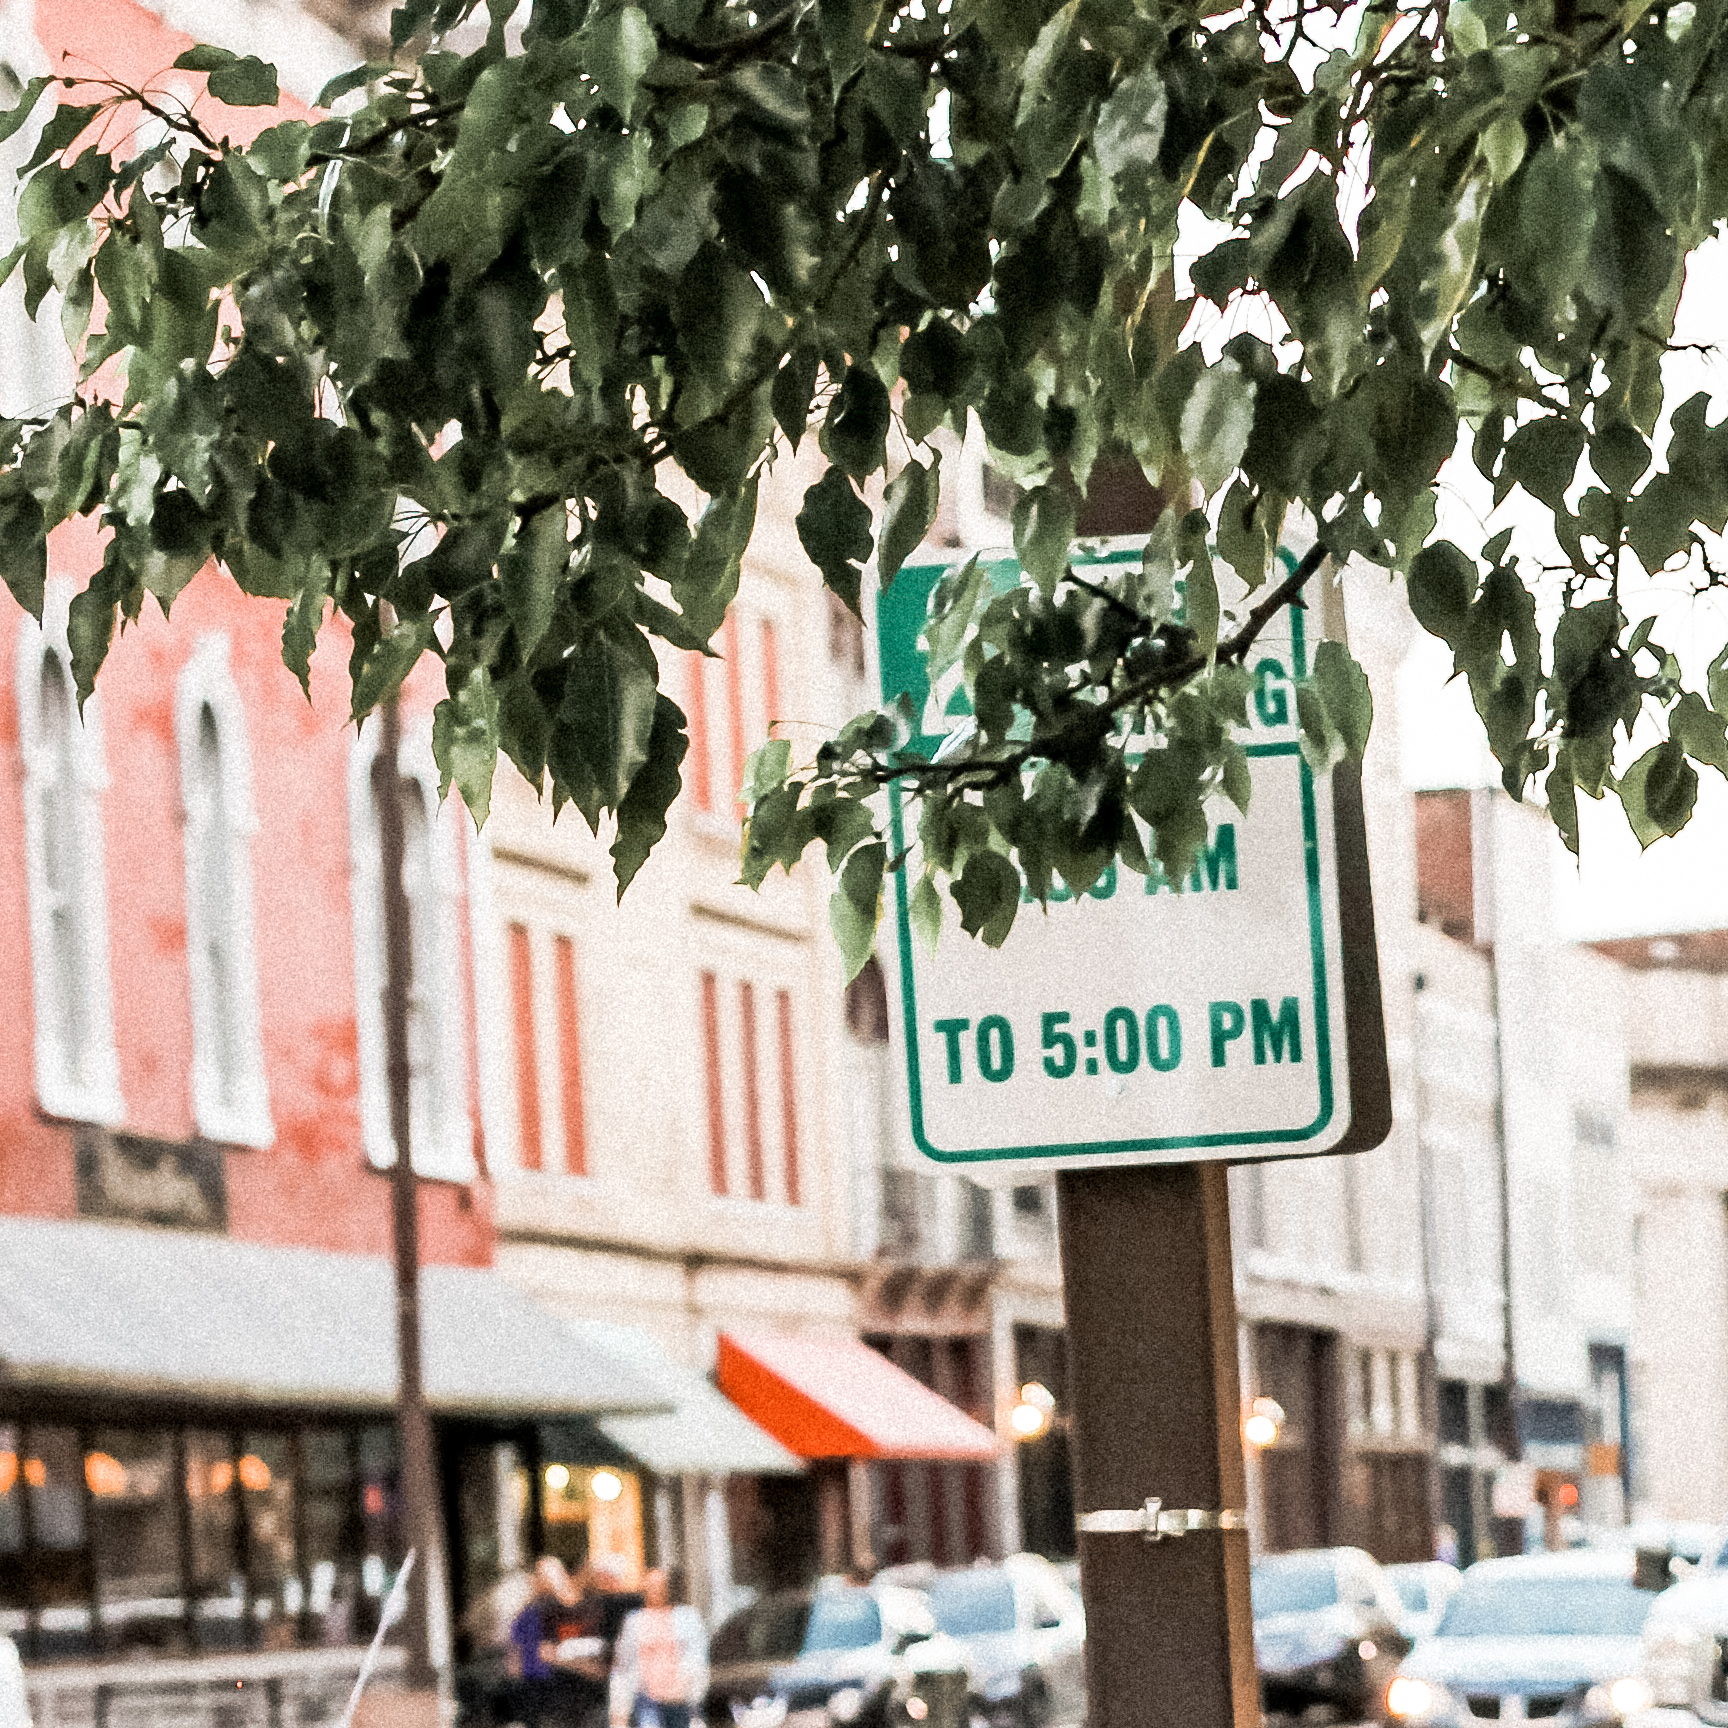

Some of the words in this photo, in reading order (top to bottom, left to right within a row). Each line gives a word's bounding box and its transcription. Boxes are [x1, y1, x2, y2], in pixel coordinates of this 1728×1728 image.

[933, 1014, 1015, 1084] TO
[1040, 1003, 1183, 1080] 5:00
[1208, 996, 1303, 1068] PM
